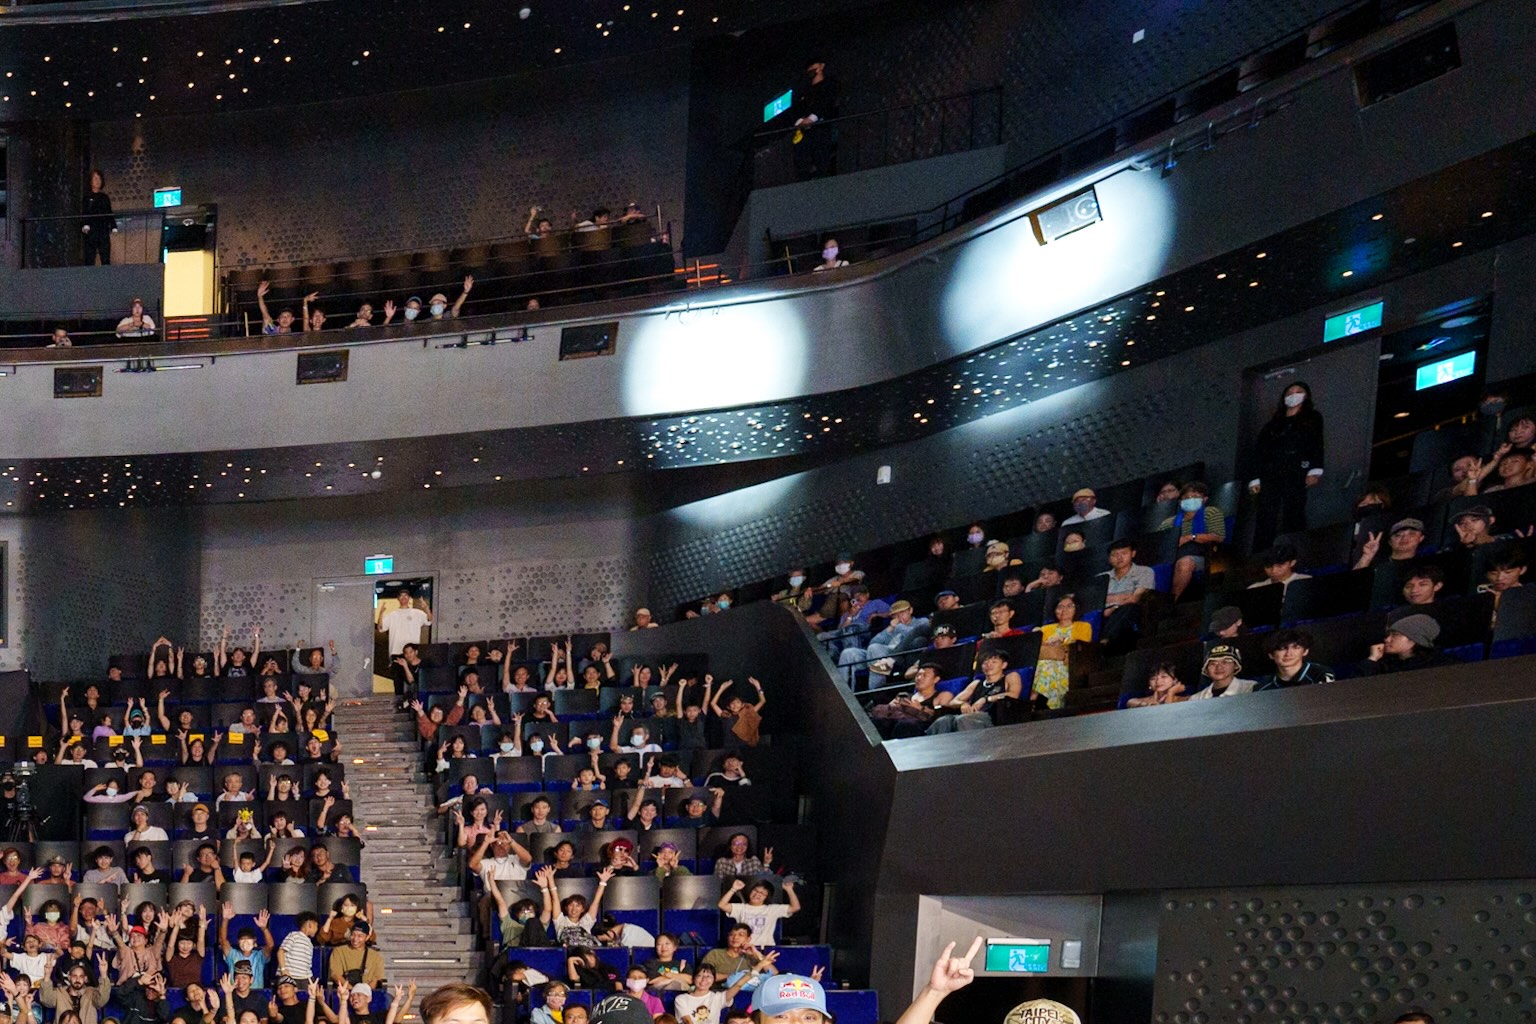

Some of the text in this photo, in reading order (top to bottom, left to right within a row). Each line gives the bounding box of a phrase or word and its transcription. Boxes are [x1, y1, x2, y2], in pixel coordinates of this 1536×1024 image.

[779, 990, 816, 1000] Red Bull
[1020, 1008, 1059, 1019] TAIPEI
